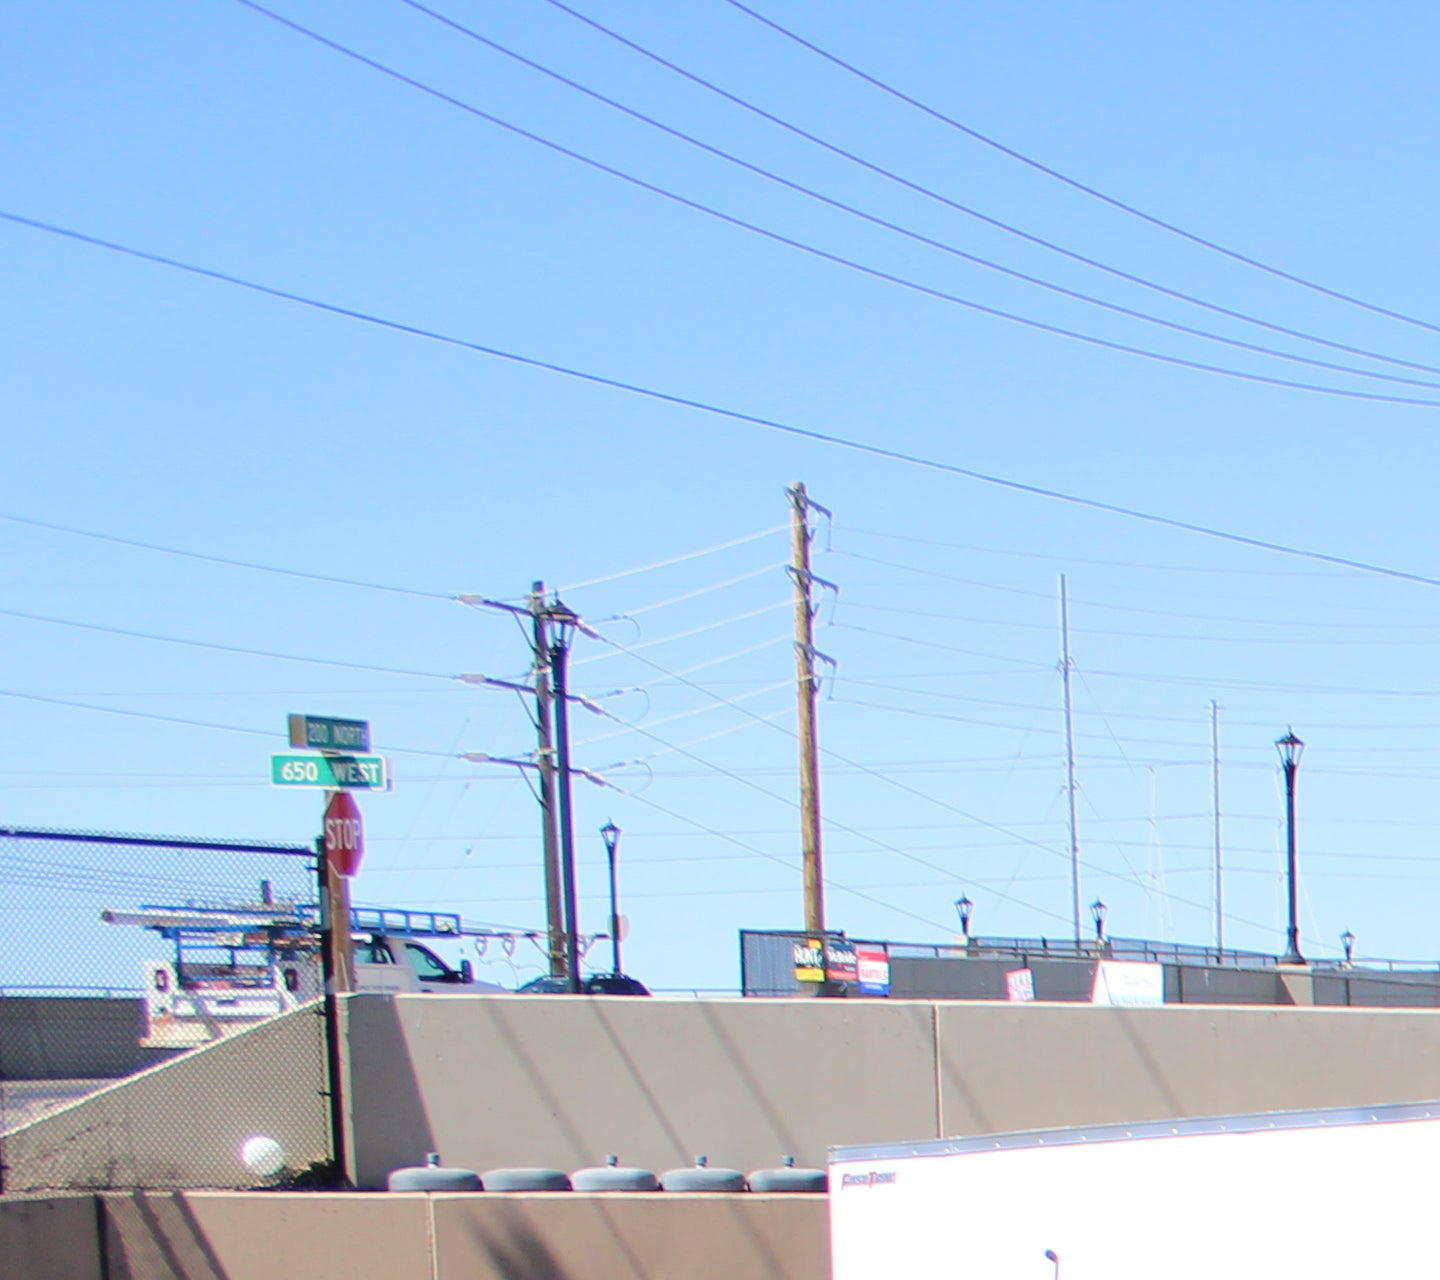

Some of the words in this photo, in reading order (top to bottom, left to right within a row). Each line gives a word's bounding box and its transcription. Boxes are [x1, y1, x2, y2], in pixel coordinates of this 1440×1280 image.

[308, 722, 329, 743] 200
[281, 761, 318, 782] 650
[331, 762, 380, 784] WEST
[325, 818, 360, 850] STOP
